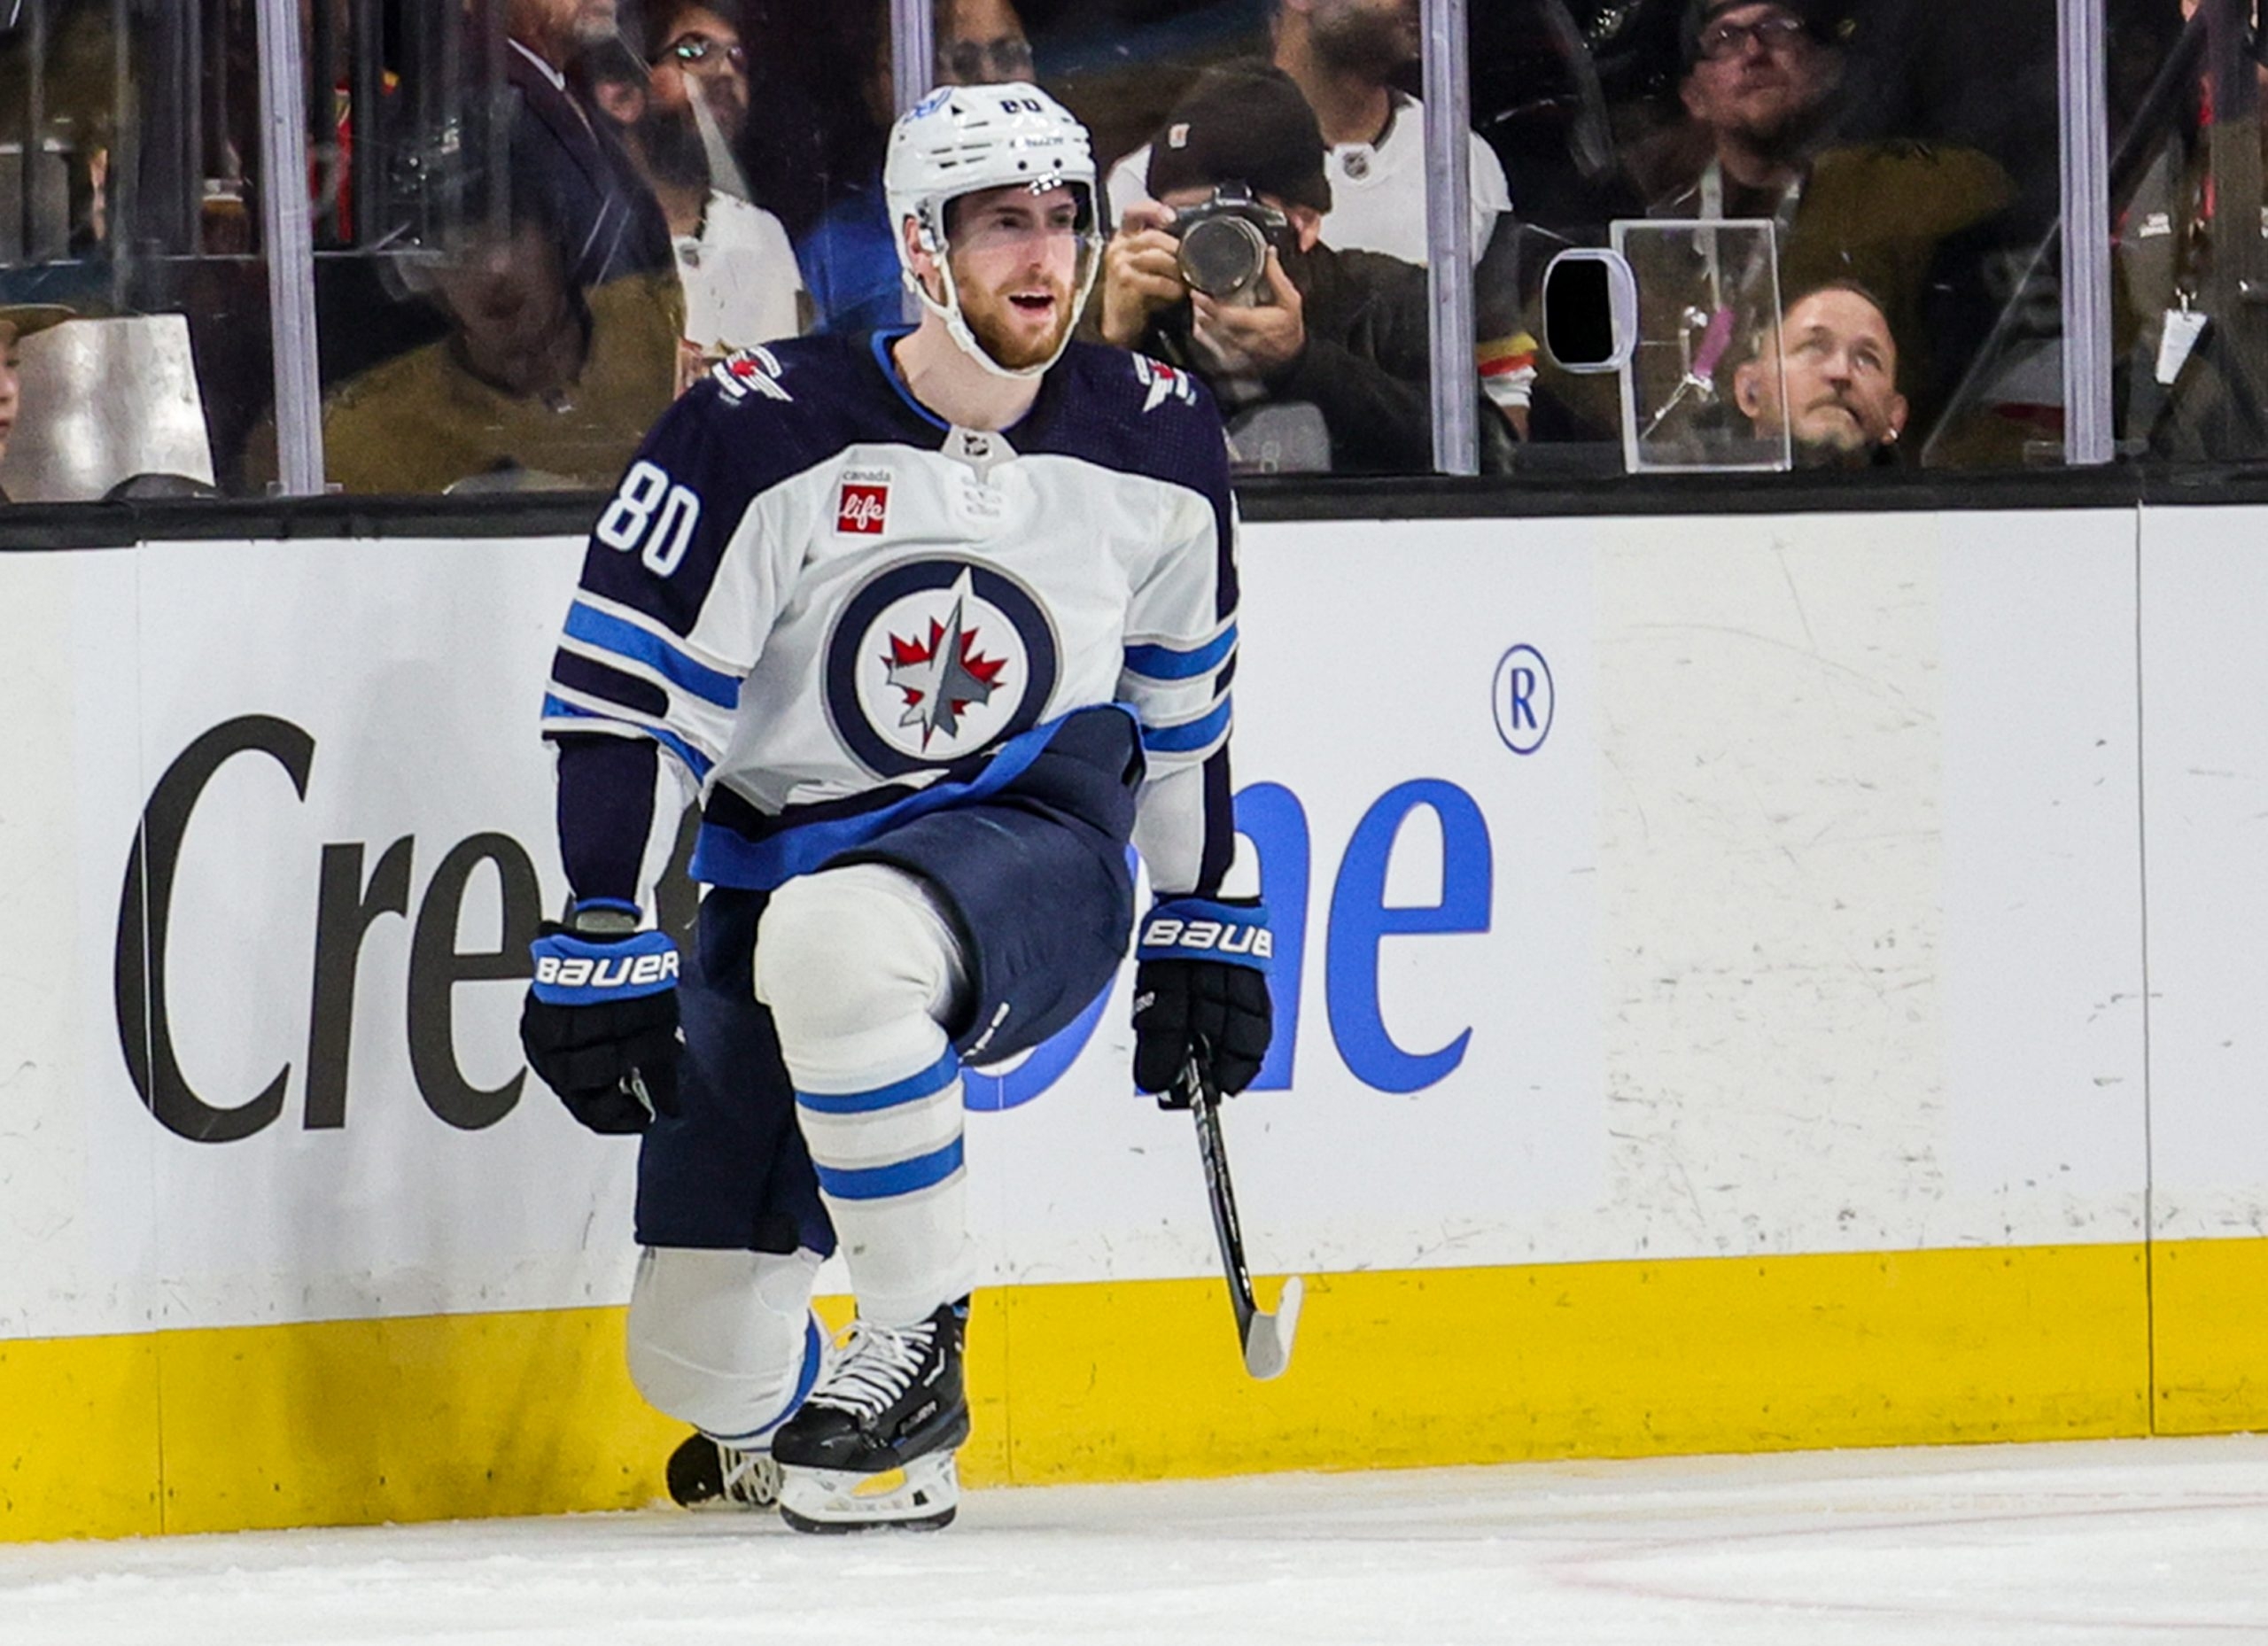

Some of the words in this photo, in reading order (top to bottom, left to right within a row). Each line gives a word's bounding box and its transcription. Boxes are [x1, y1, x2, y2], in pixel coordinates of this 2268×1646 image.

[843, 468, 890, 482] canada
[596, 460, 700, 577] 80
[839, 493, 884, 530] life
